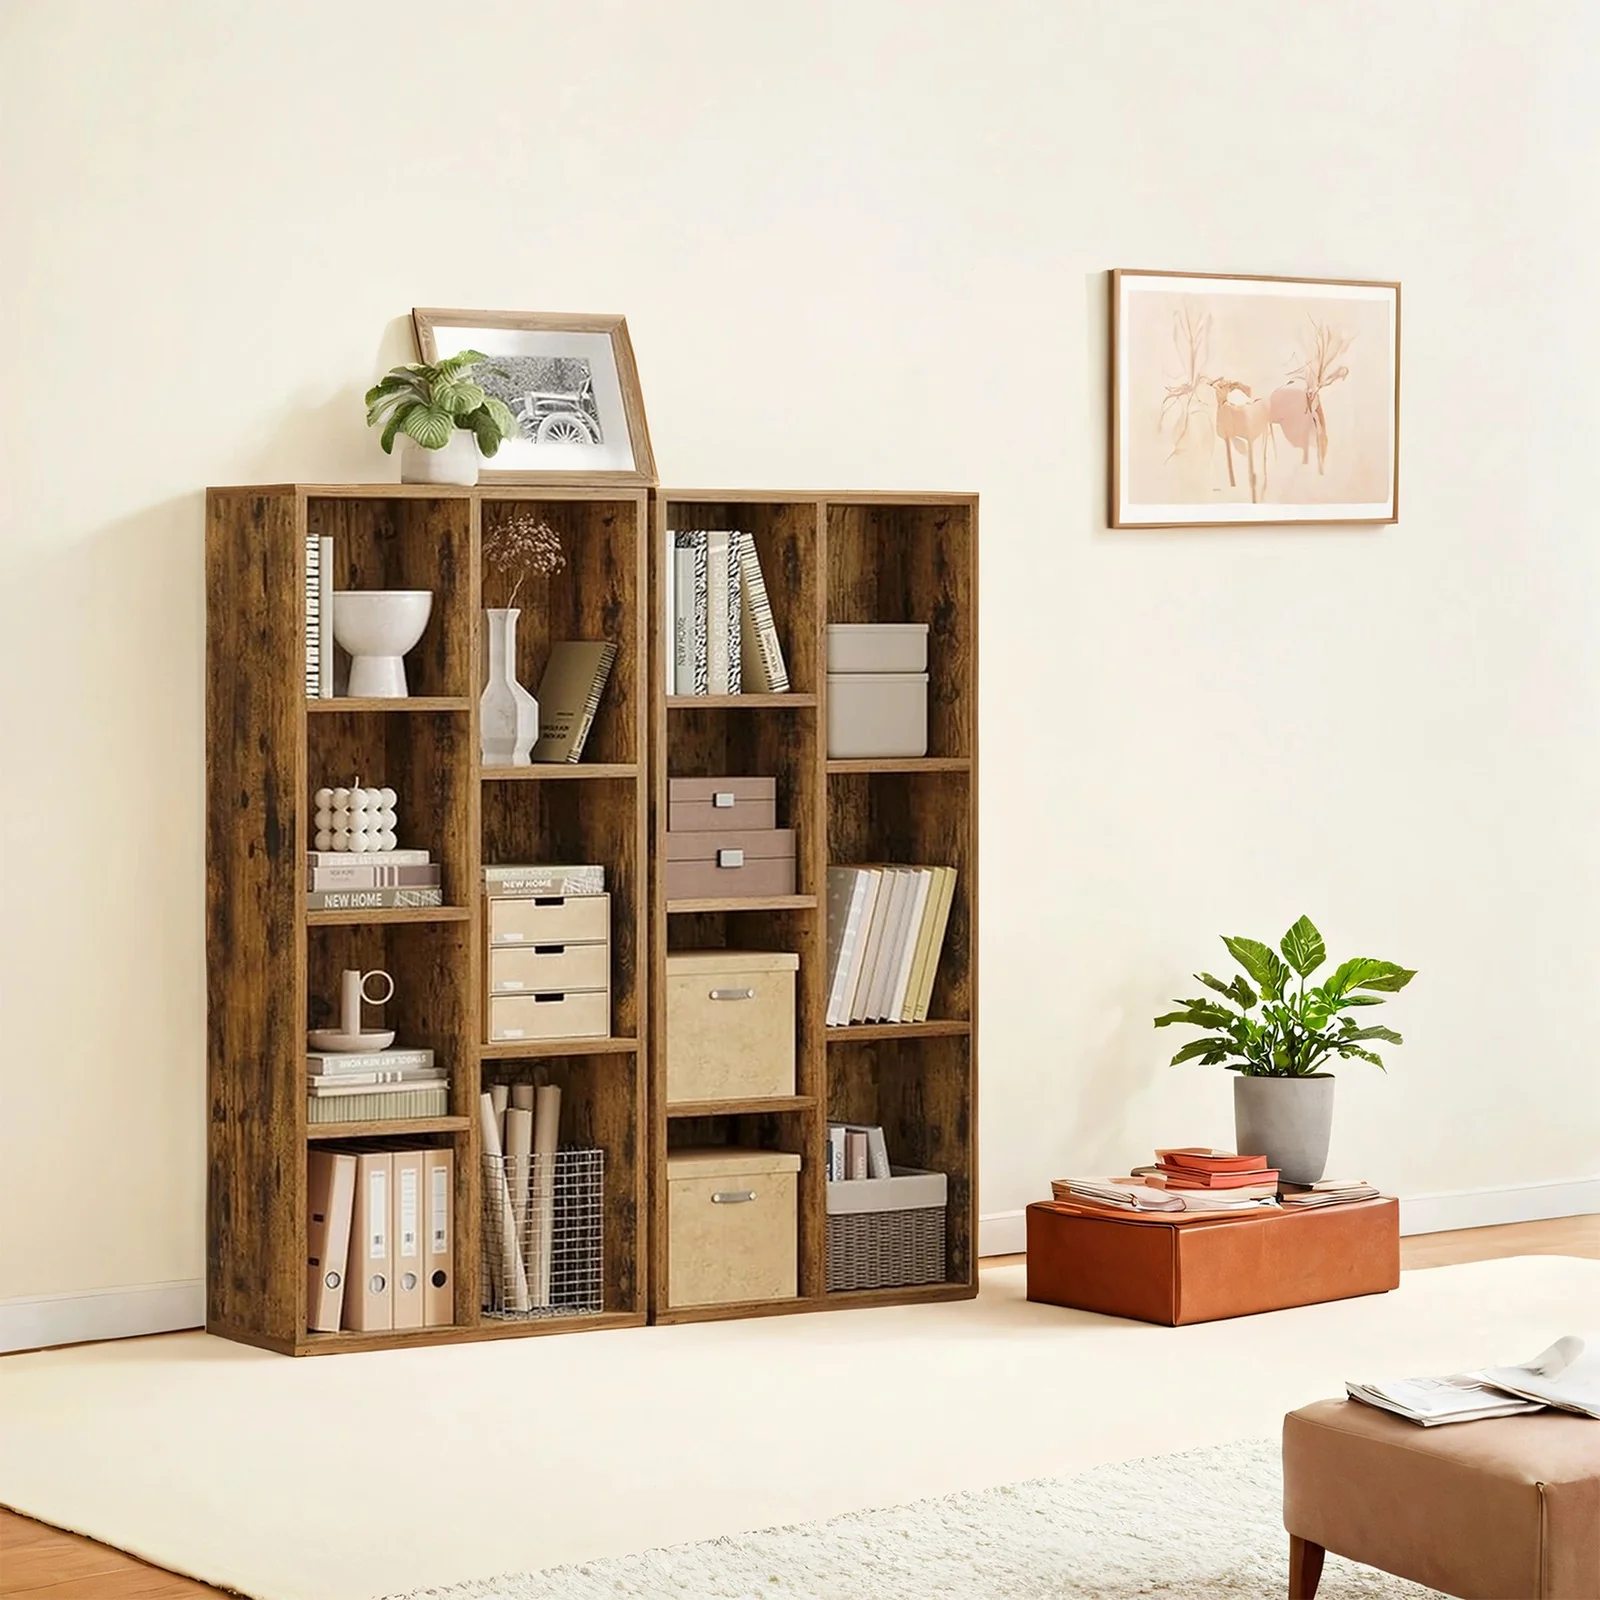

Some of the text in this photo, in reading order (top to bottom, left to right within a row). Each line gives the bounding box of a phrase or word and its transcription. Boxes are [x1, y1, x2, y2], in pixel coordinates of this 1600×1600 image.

[503, 880, 525, 889] NEW
[325, 893, 382, 908] NEW HOME
